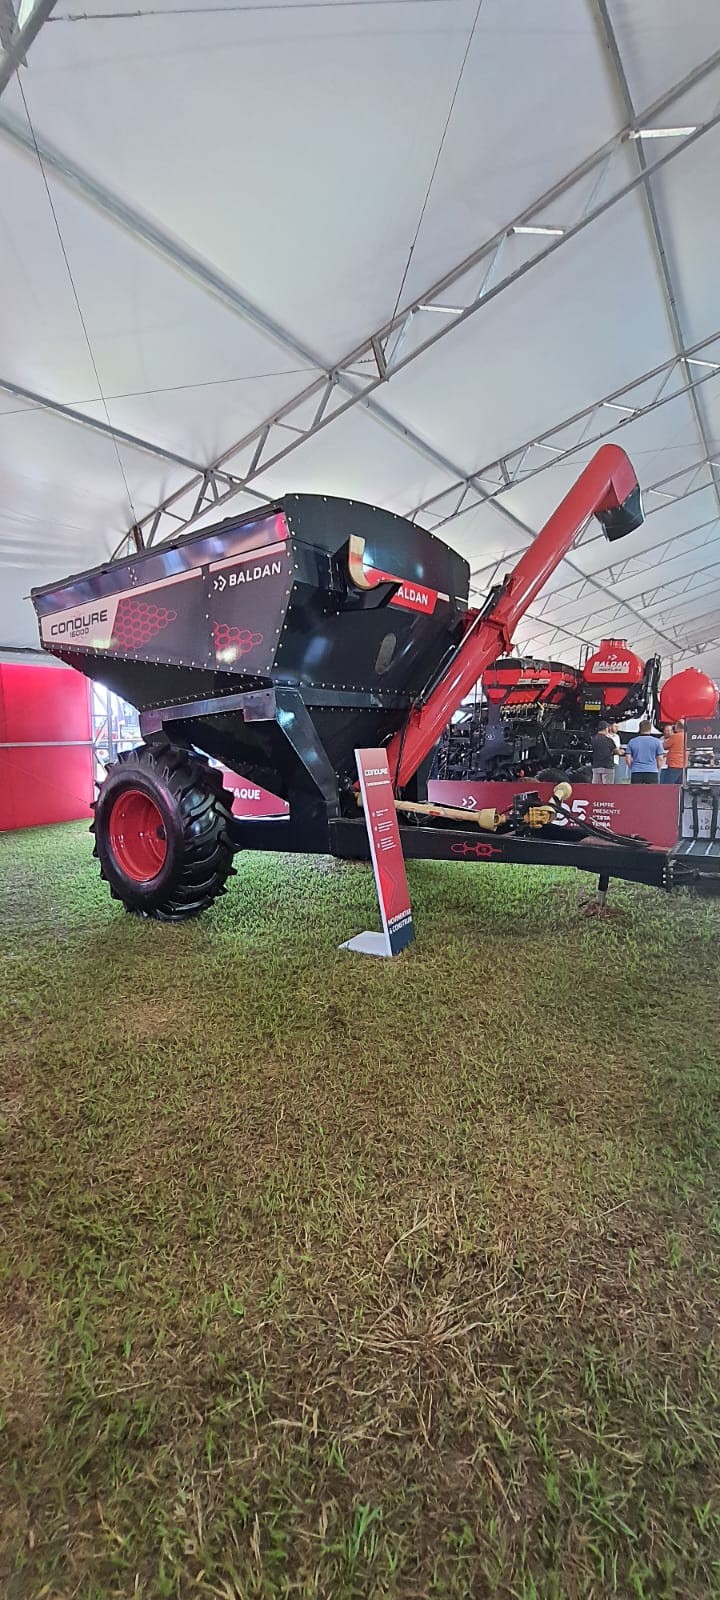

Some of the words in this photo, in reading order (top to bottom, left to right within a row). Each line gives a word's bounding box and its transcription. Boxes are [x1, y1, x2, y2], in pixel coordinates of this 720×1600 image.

[229, 561, 281, 587] BALDAN
[396, 586, 429, 606] ALDAN
[51, 609, 108, 636] CONDURE
